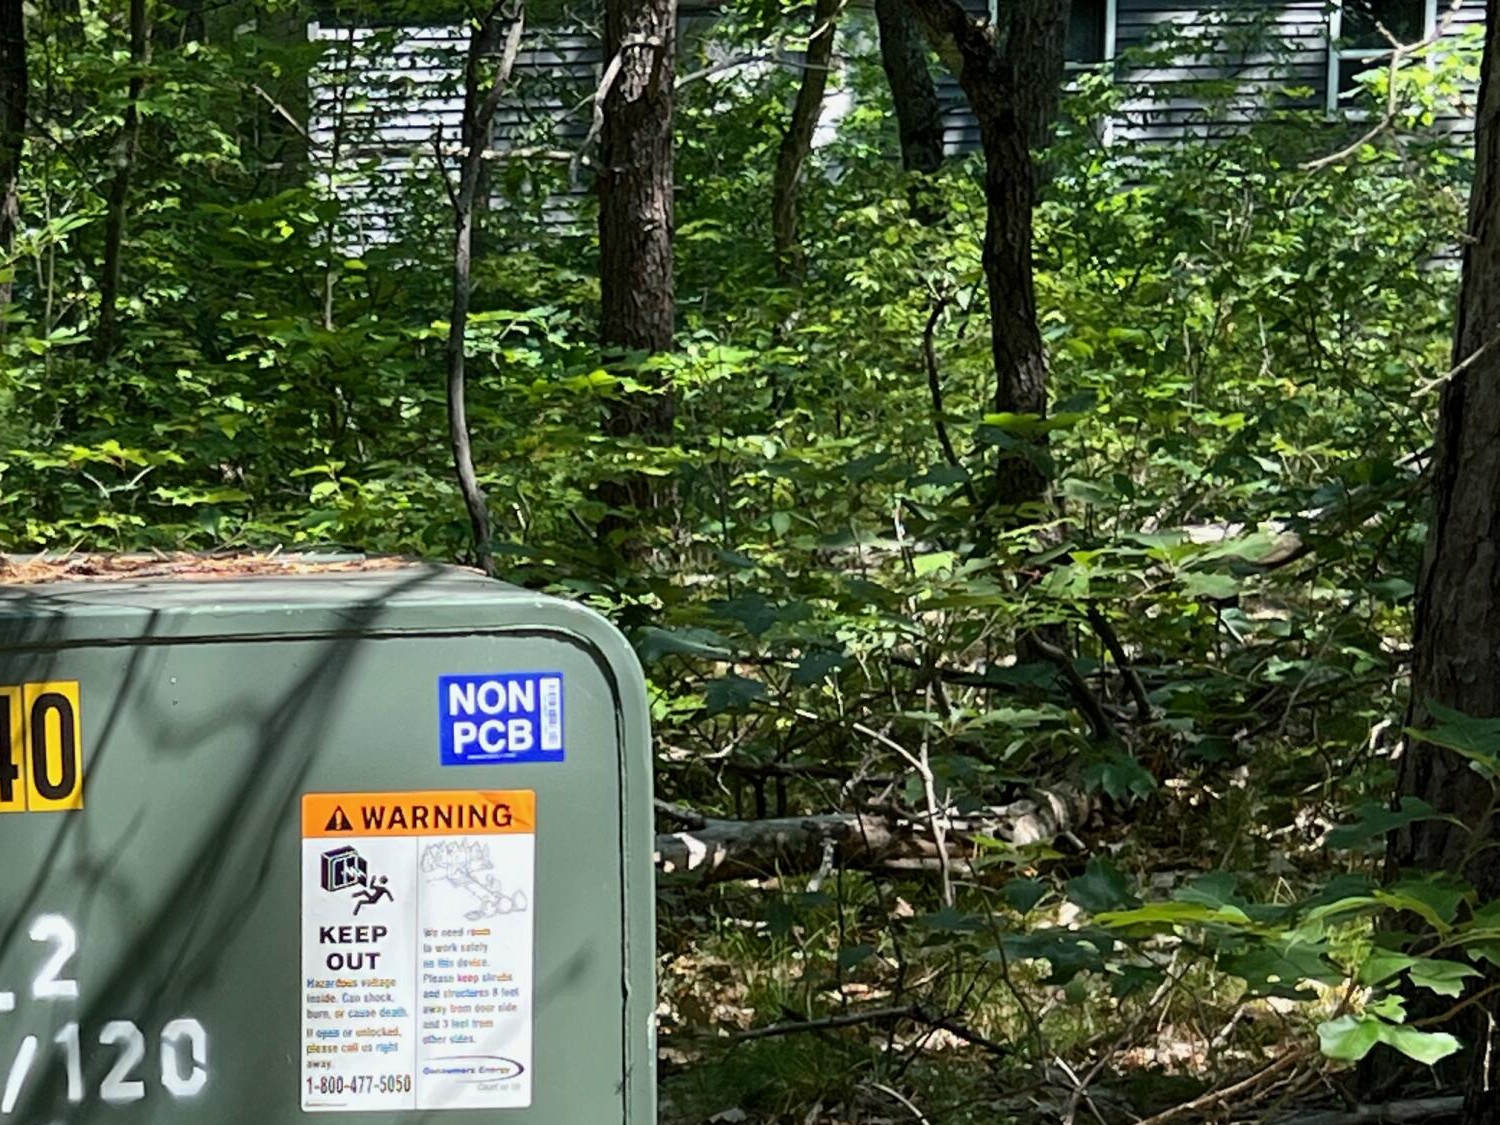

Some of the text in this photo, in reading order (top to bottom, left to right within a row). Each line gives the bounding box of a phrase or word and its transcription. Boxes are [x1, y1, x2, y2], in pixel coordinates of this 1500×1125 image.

[449, 679, 534, 716] NON
[453, 718, 534, 754] PCB
[361, 804, 512, 829] WARNING
[320, 926, 388, 944] KEEP
[441, 928, 463, 937] need
[423, 942, 488, 953] to work safely
[326, 952, 381, 971] OUT
[423, 960, 434, 968] on
[438, 959, 454, 968] this
[423, 972, 513, 983] Please keep shrubs
[307, 978, 396, 989] Hazardous voltage
[342, 992, 360, 1003] Can
[423, 990, 440, 998] and
[443, 989, 489, 998] structures
[501, 988, 518, 997] feet
[334, 1010, 344, 1018] or
[348, 1009, 376, 1018] cause
[423, 1003, 517, 1015] away from door side
[423, 1019, 494, 1028] and 3 feet from
[315, 1030, 339, 1040] open
[422, 1035, 446, 1044] other
[307, 1042, 397, 1055] please call us right
[423, 1065, 510, 1075] Consumers Energy
[307, 1075, 411, 1094] 1-800-477-5050
